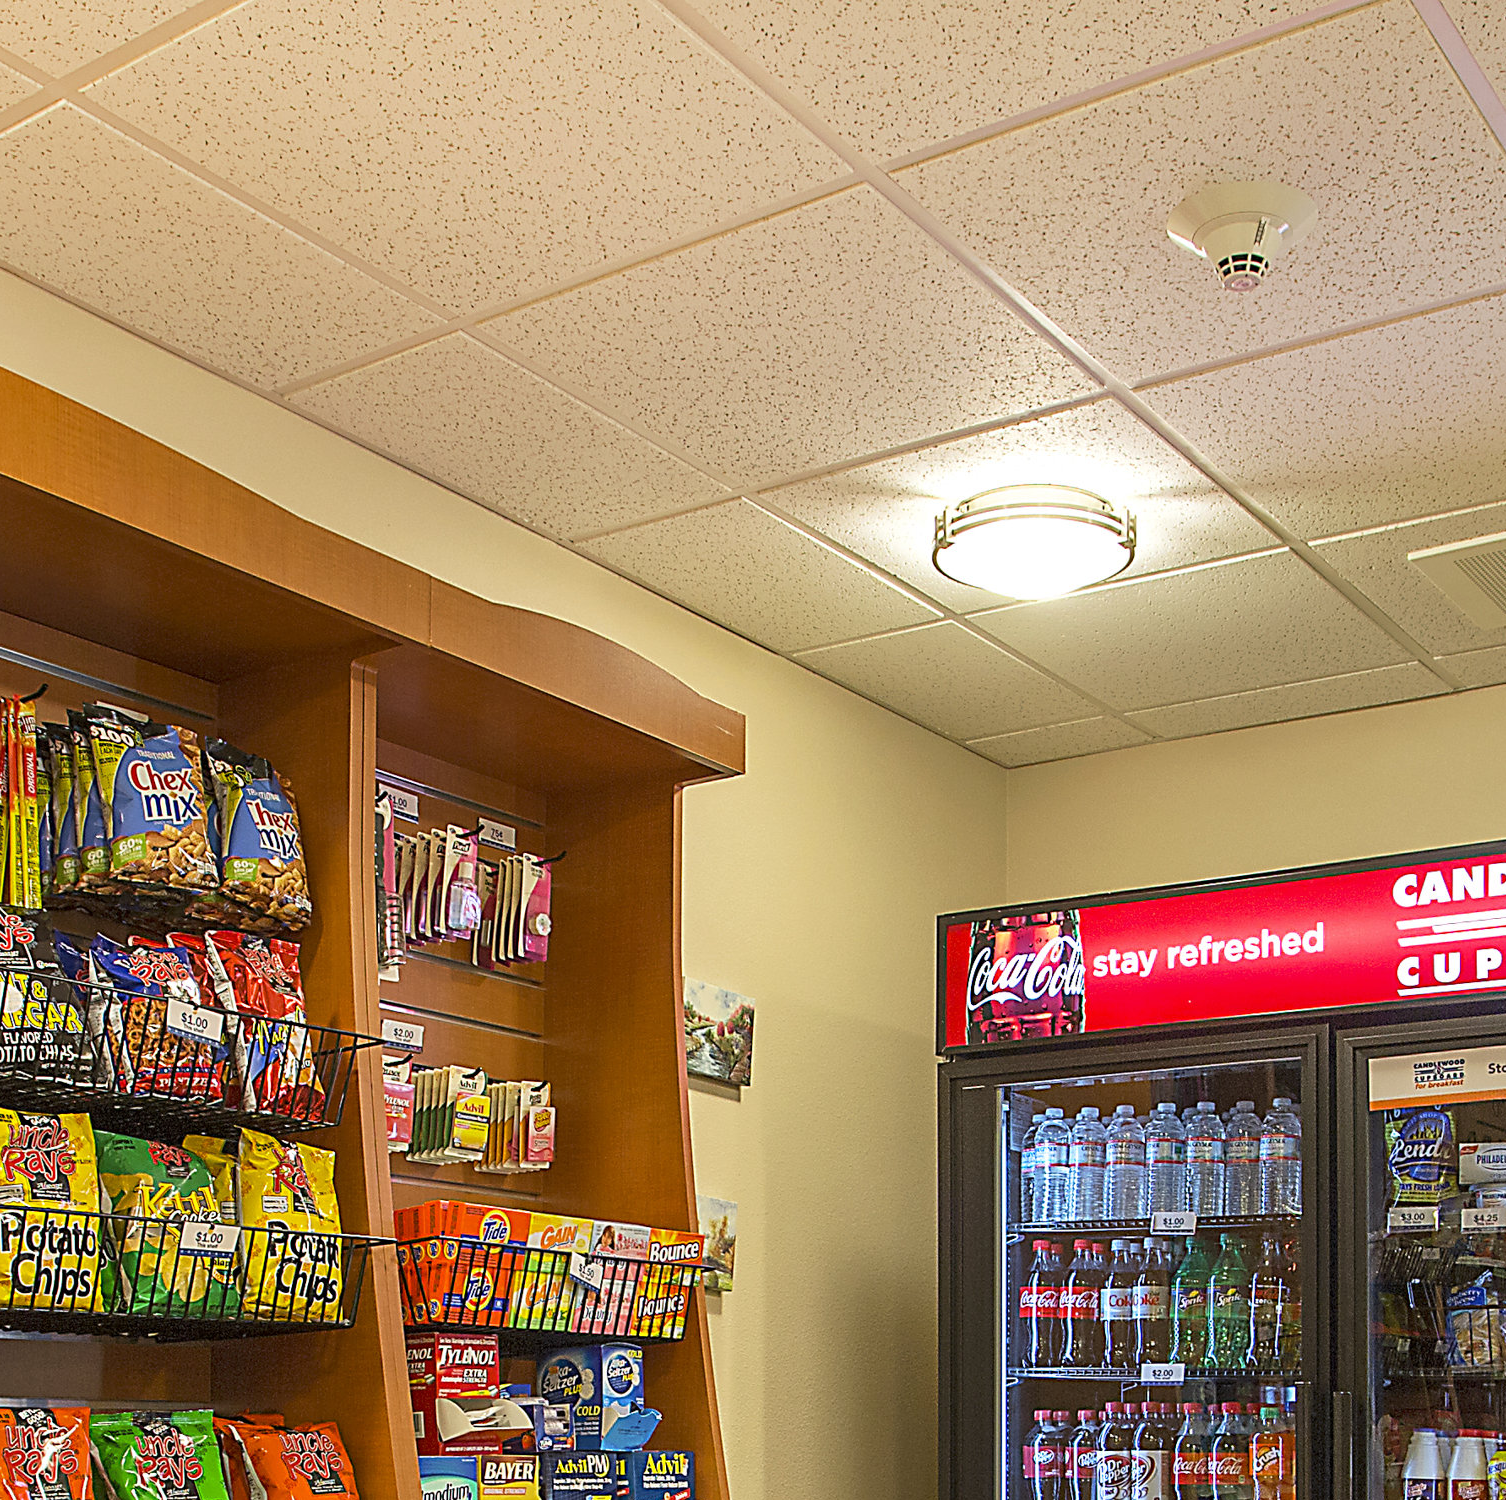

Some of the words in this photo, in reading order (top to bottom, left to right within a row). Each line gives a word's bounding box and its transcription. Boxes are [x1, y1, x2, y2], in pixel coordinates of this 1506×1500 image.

[129, 760, 194, 793] Chex
[144, 788, 200, 824] mix
[1092, 947, 1158, 978] stay
[1166, 922, 1325, 969] refreshed
[1413, 1058, 1466, 1070] CANDLEWOOD
[1414, 1072, 1465, 1082] CUPBOARD
[1427, 1078, 1464, 1089] breakfast
[1162, 1217, 1185, 1226] $1.00
[195, 1231, 224, 1245] $1.00
[483, 1220, 509, 1242] Tide
[649, 1241, 700, 1263] Bounce
[1152, 1368, 1174, 1378] $2.00
[484, 1461, 534, 1480] BAYER
